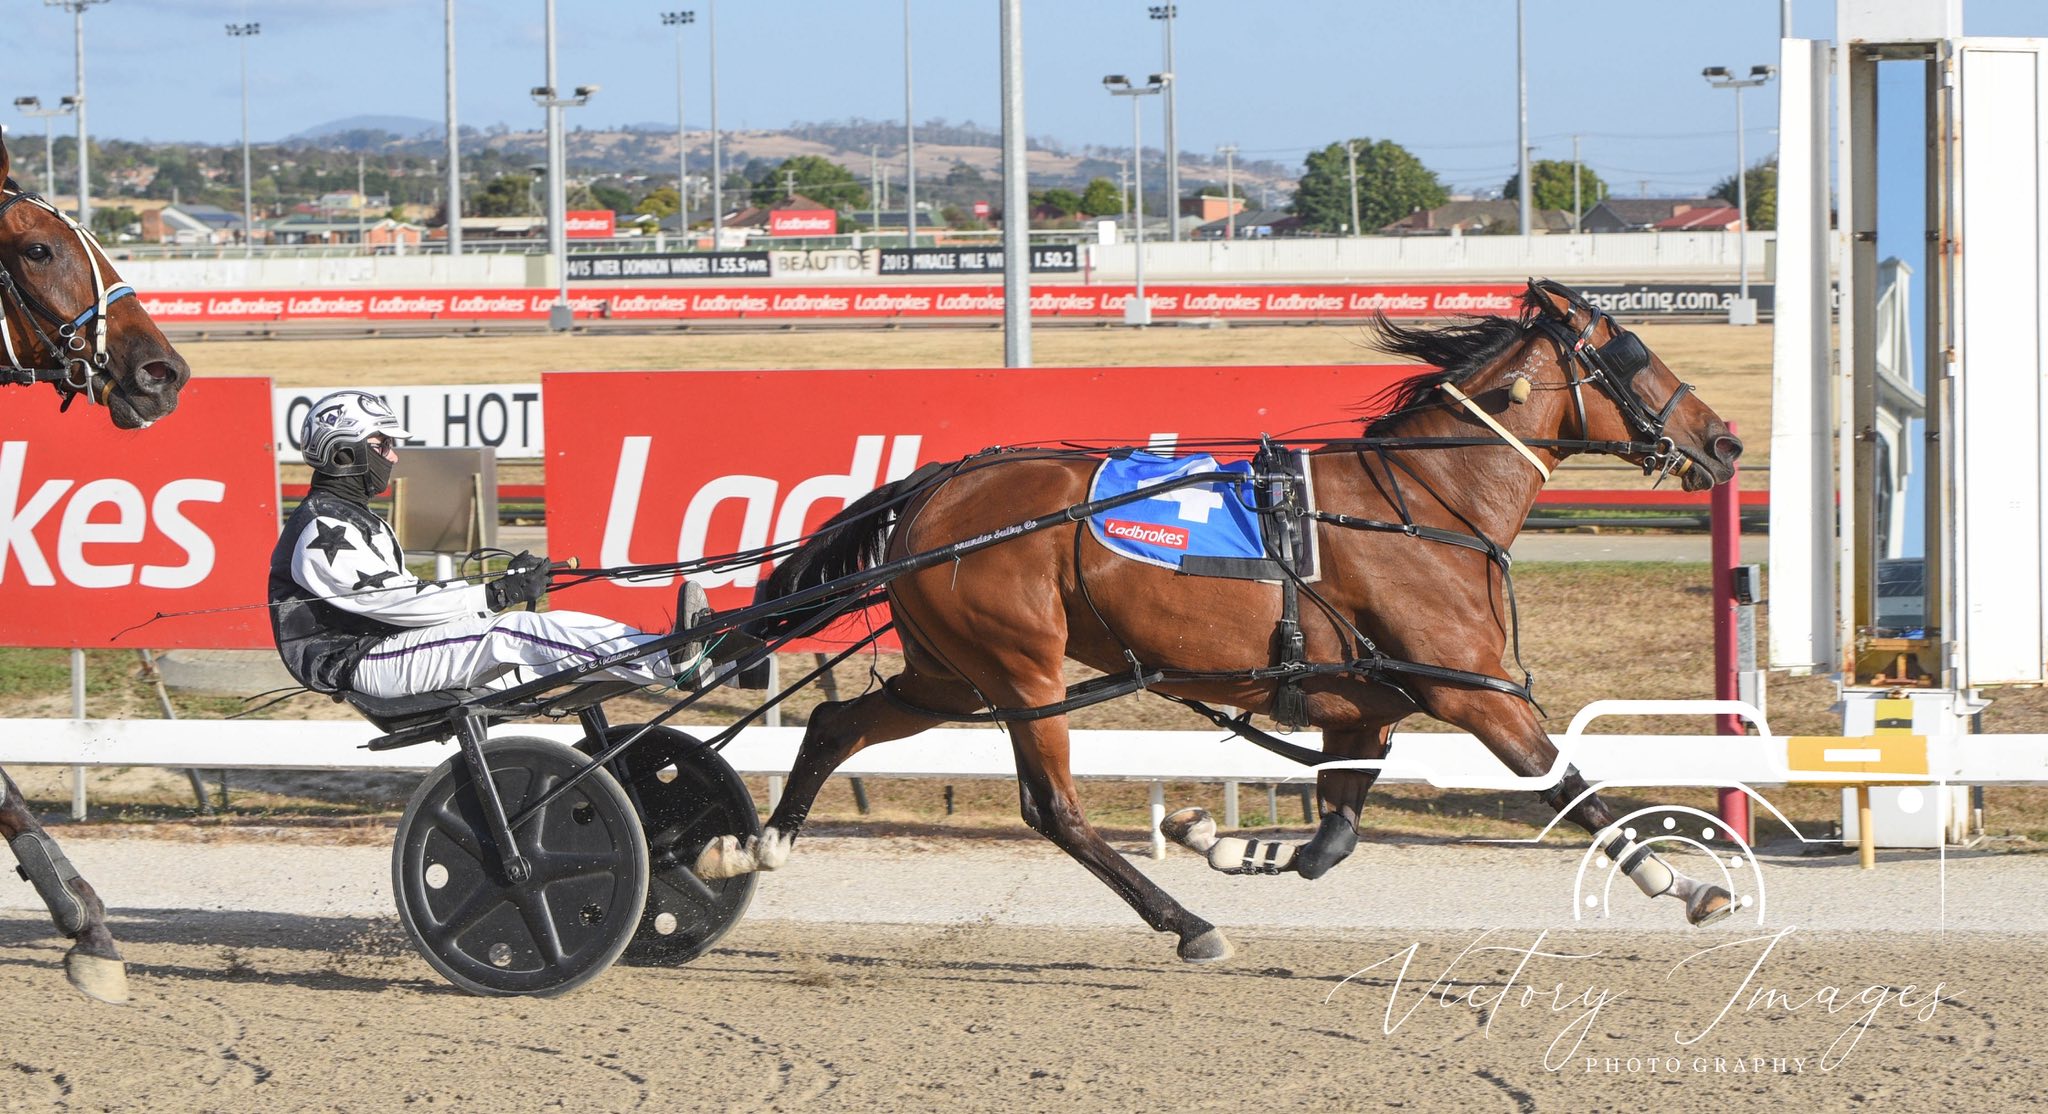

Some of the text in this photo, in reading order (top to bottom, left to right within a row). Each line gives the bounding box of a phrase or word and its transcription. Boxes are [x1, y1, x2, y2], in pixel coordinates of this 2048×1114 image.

[566, 217, 609, 231] dbrokes
[774, 217, 831, 231] Ladbrokes
[593, 259, 621, 275] INTER
[622, 258, 670, 275] DOMINION
[671, 257, 710, 273] WINNER
[881, 254, 910, 270] 2013
[912, 253, 956, 270] MIRACLE
[959, 252, 984, 269] MILE
[1034, 251, 1074, 267] 1.50.2
[143, 298, 203, 315] dbrokes
[207, 297, 284, 315] Ladbrokes
[287, 296, 364, 314] Ladbrokes
[368, 296, 445, 313] Ladbrokes
[450, 295, 526, 313] Ladbrokes
[611, 294, 687, 312] Ladbrokes
[692, 294, 768, 311] Ladbrokes
[773, 294, 849, 311] Ladbrokes
[854, 294, 930, 310] Ladbrokes
[936, 293, 1004, 310] Ladbroke
[1029, 293, 1095, 310] adbrokes
[1183, 293, 1260, 310] Ladbrokes
[1265, 293, 1344, 310] Ladbrokes
[1349, 292, 1428, 310] Ladbrokes
[1433, 292, 1513, 310] Ladbrokes
[1580, 286, 1742, 312] tasracing.com.a
[1107, 522, 1185, 546] Ladbrokes
